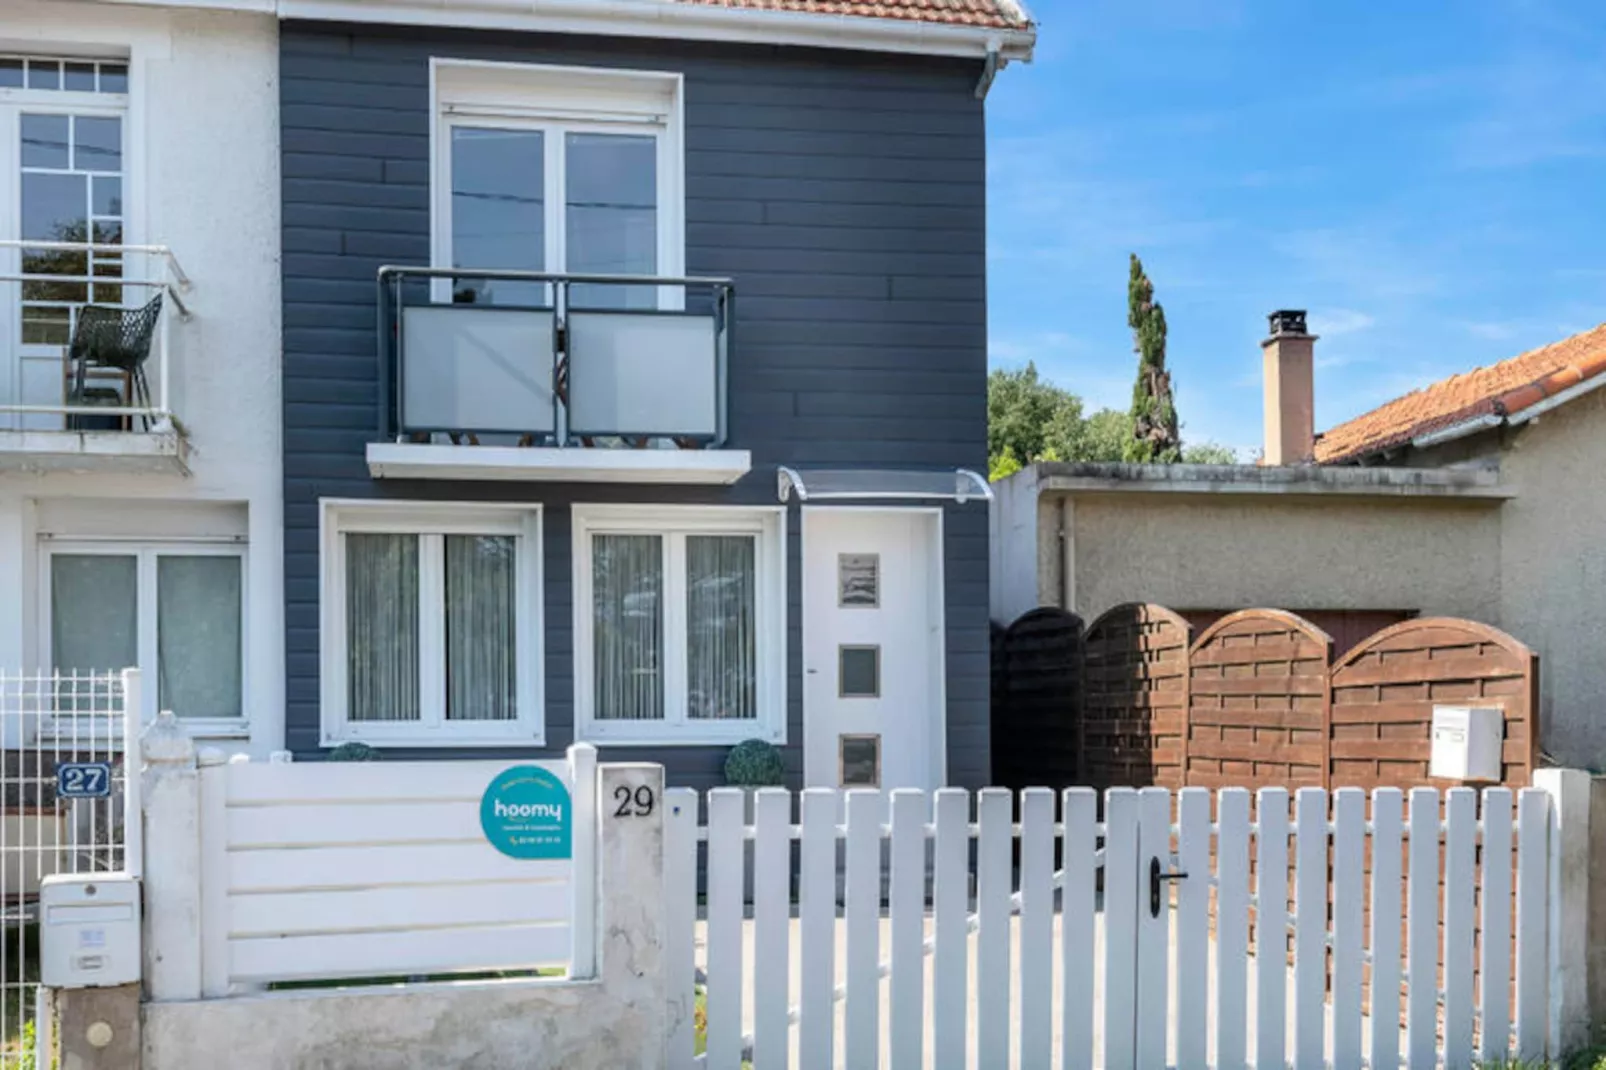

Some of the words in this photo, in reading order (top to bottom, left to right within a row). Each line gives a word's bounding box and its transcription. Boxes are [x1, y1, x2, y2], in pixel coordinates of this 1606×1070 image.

[65, 769, 102, 791] 27
[494, 798, 562, 821] hoomy
[613, 785, 654, 818] 29
